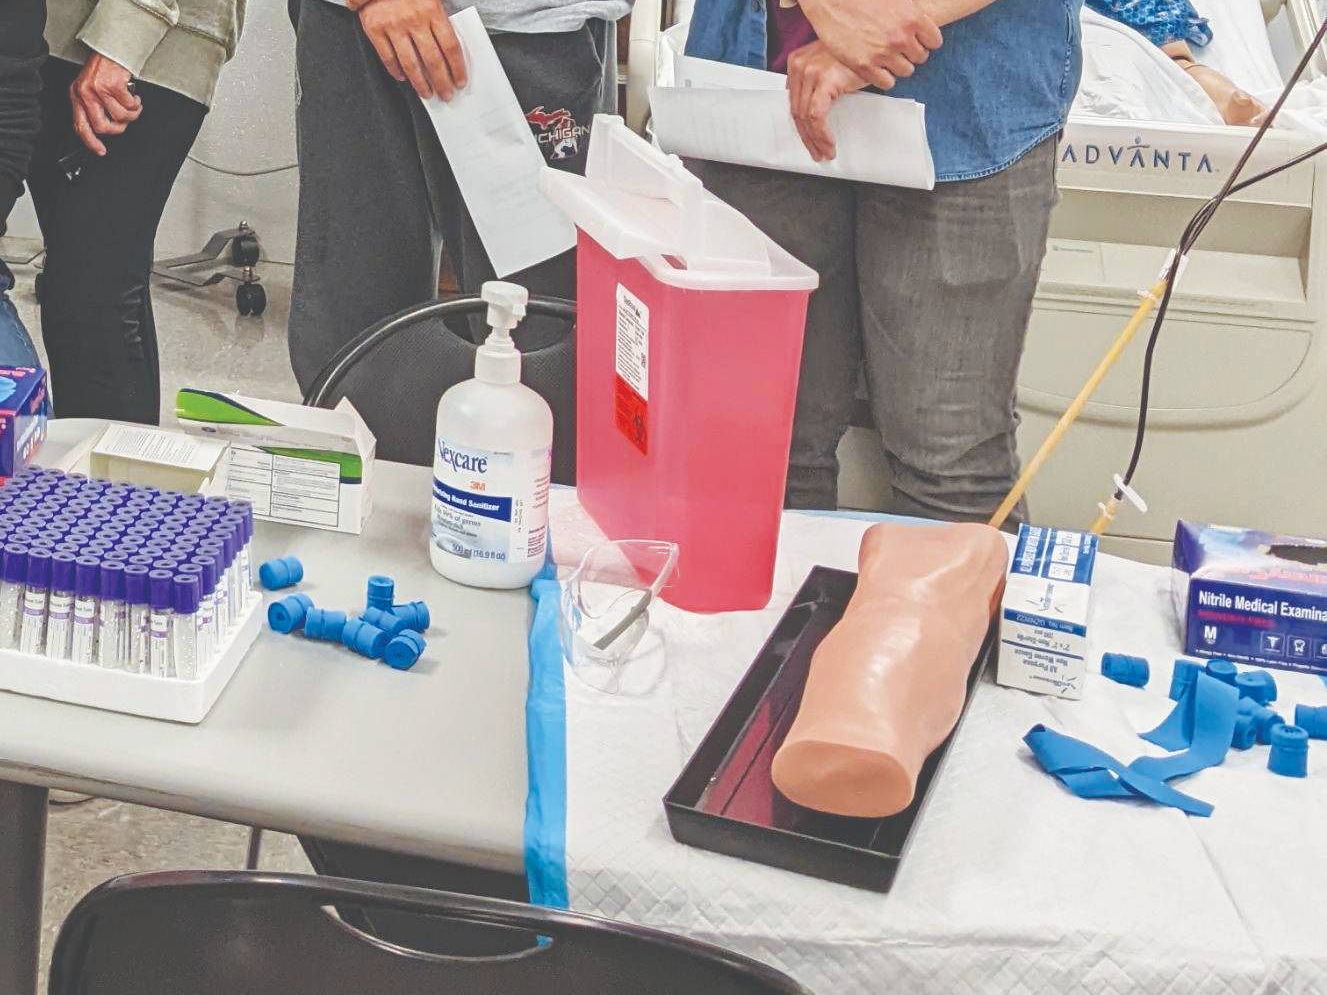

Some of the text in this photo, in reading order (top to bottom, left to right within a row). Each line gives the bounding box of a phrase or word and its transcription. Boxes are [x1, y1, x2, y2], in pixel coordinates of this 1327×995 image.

[1062, 142, 1212, 173] ADVANTA
[438, 436, 487, 473] Nexcare
[470, 480, 486, 492] 3M
[451, 494, 467, 506] Hand
[468, 499, 500, 511] Sanitizer
[1198, 590, 1232, 608] Nitrile
[1234, 595, 1278, 615] Medical
[1204, 626, 1217, 640] M
